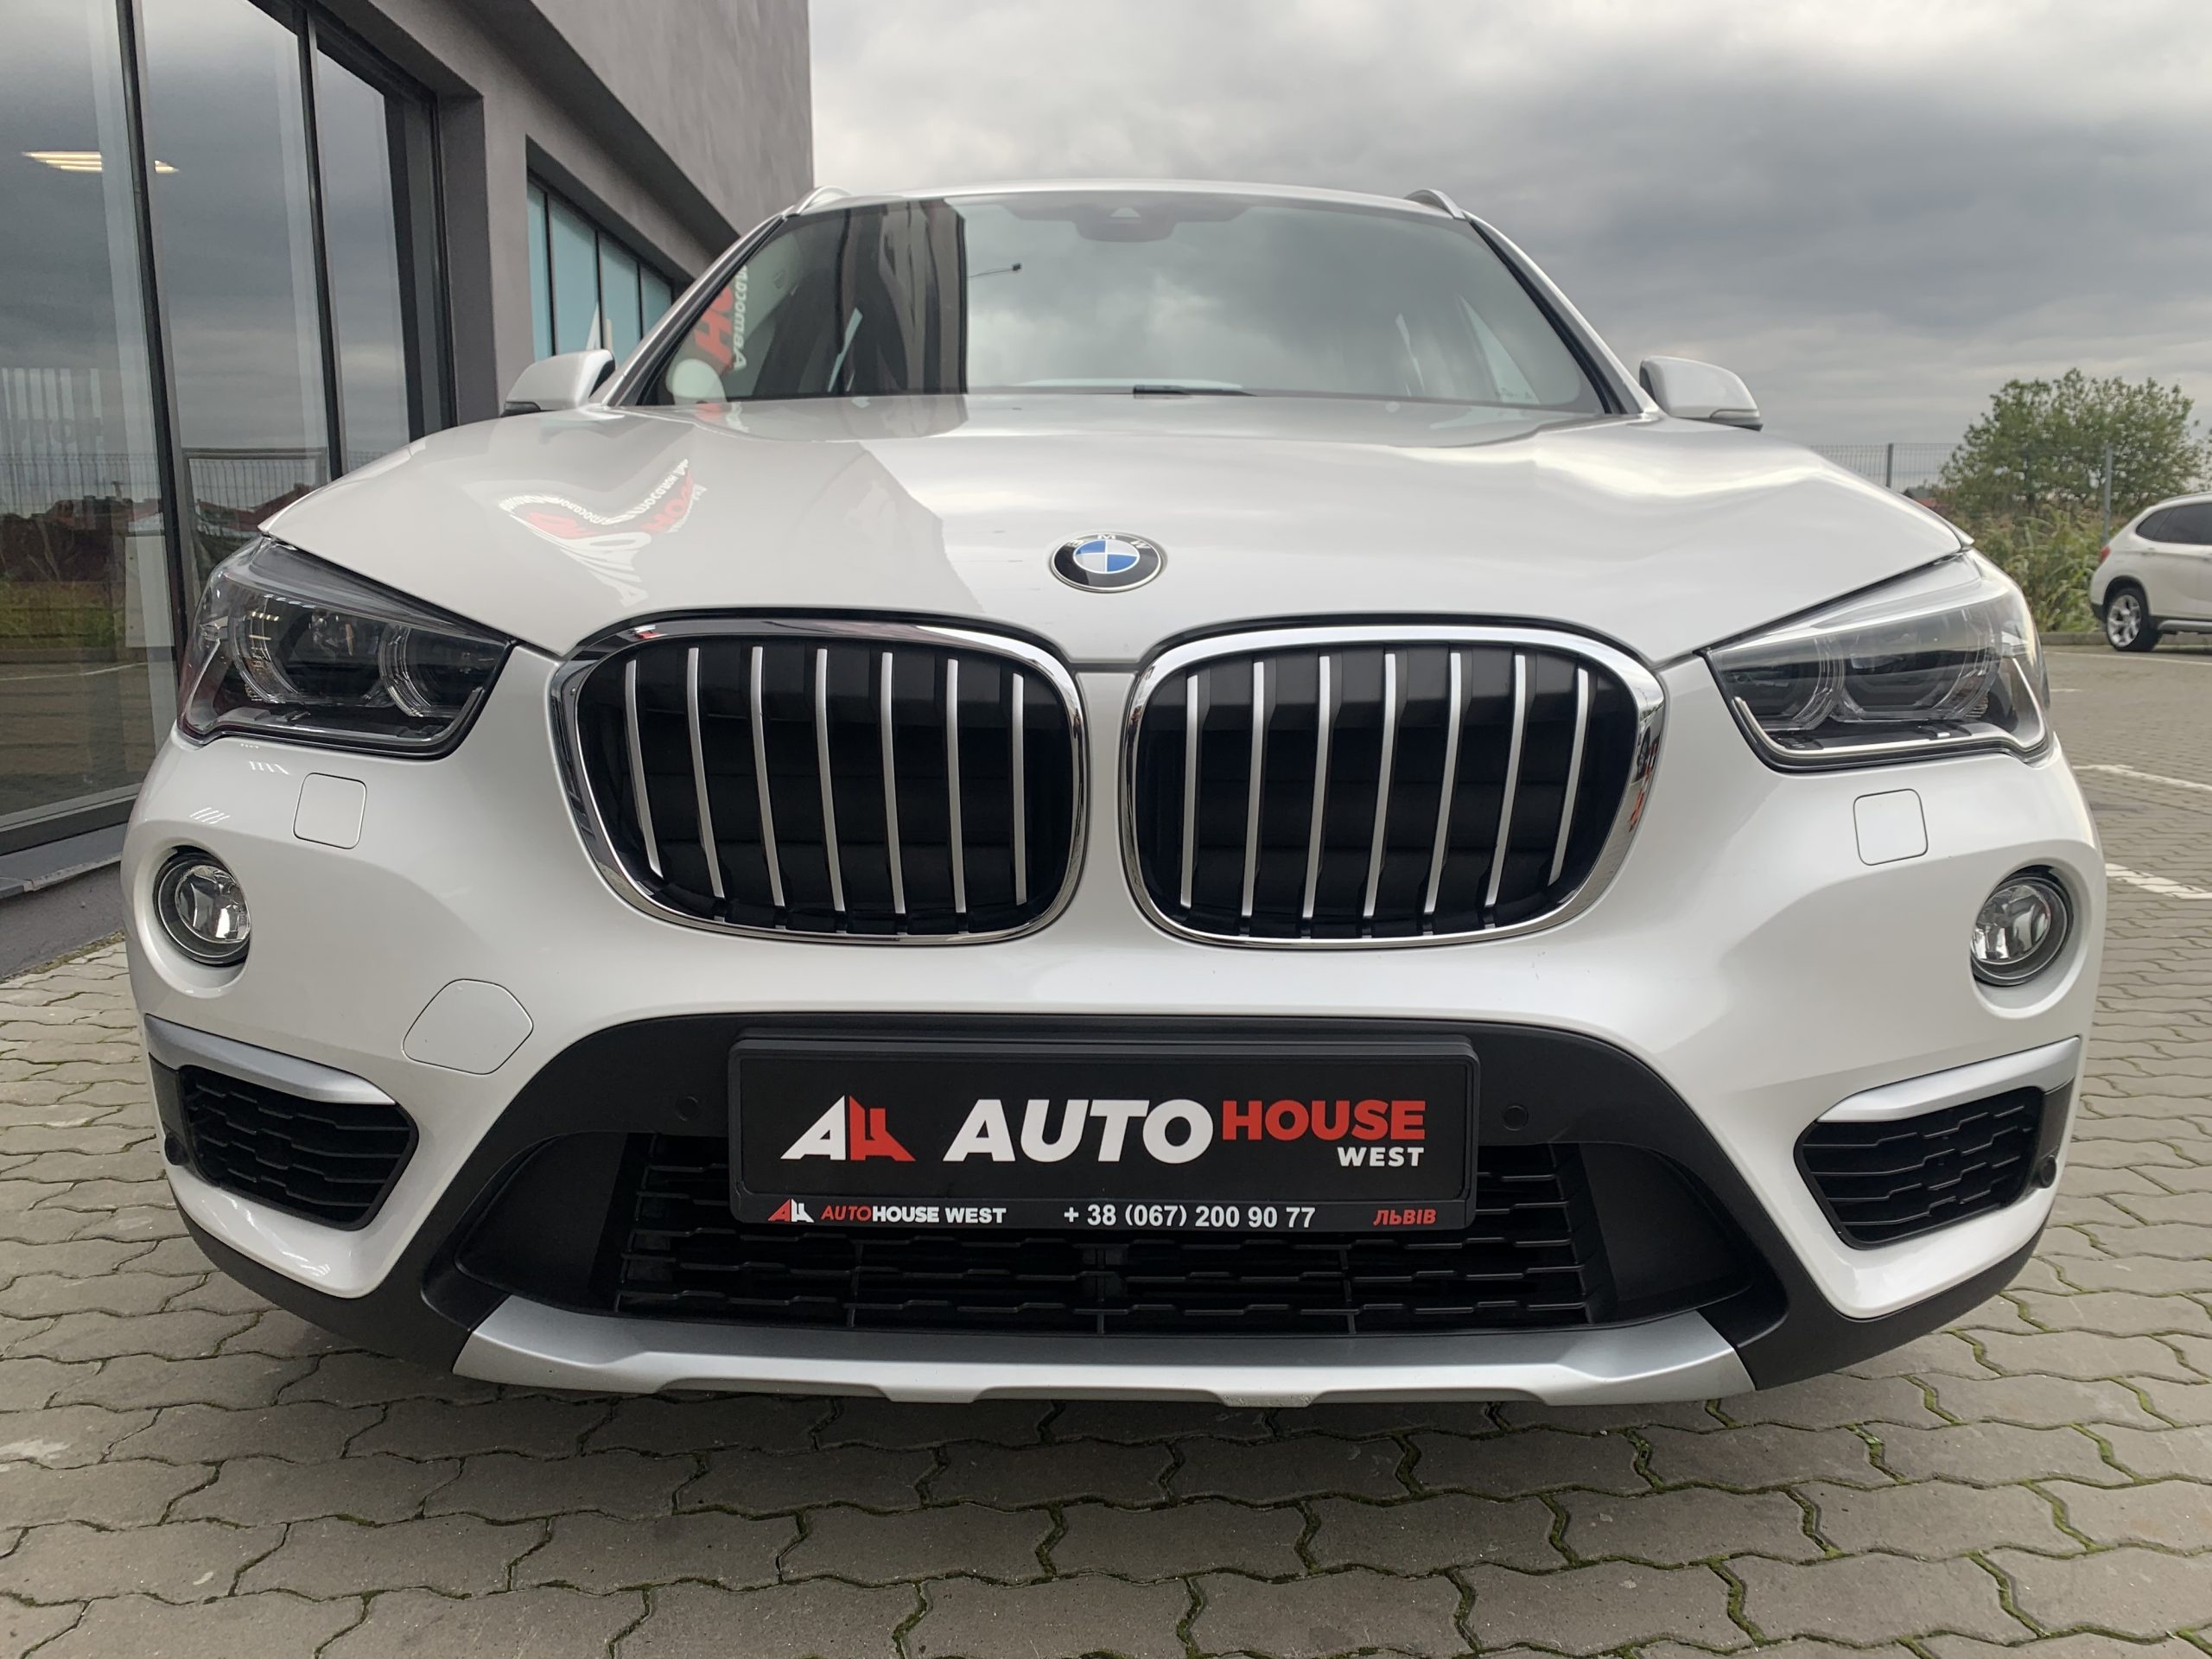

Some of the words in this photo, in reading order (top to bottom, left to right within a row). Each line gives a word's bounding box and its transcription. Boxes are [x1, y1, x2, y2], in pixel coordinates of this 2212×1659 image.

[1066, 533, 1151, 550] BMW
[1337, 1147, 1425, 1167] WEST
[944, 1207, 1007, 1224] WEST
[1124, 1204, 1187, 1227] (067)
[1195, 1205, 1240, 1228] 200
[1248, 1206, 1278, 1228] 90
[1286, 1206, 1316, 1228] 77
[1373, 1209, 1437, 1226] ЛЬВІВ
